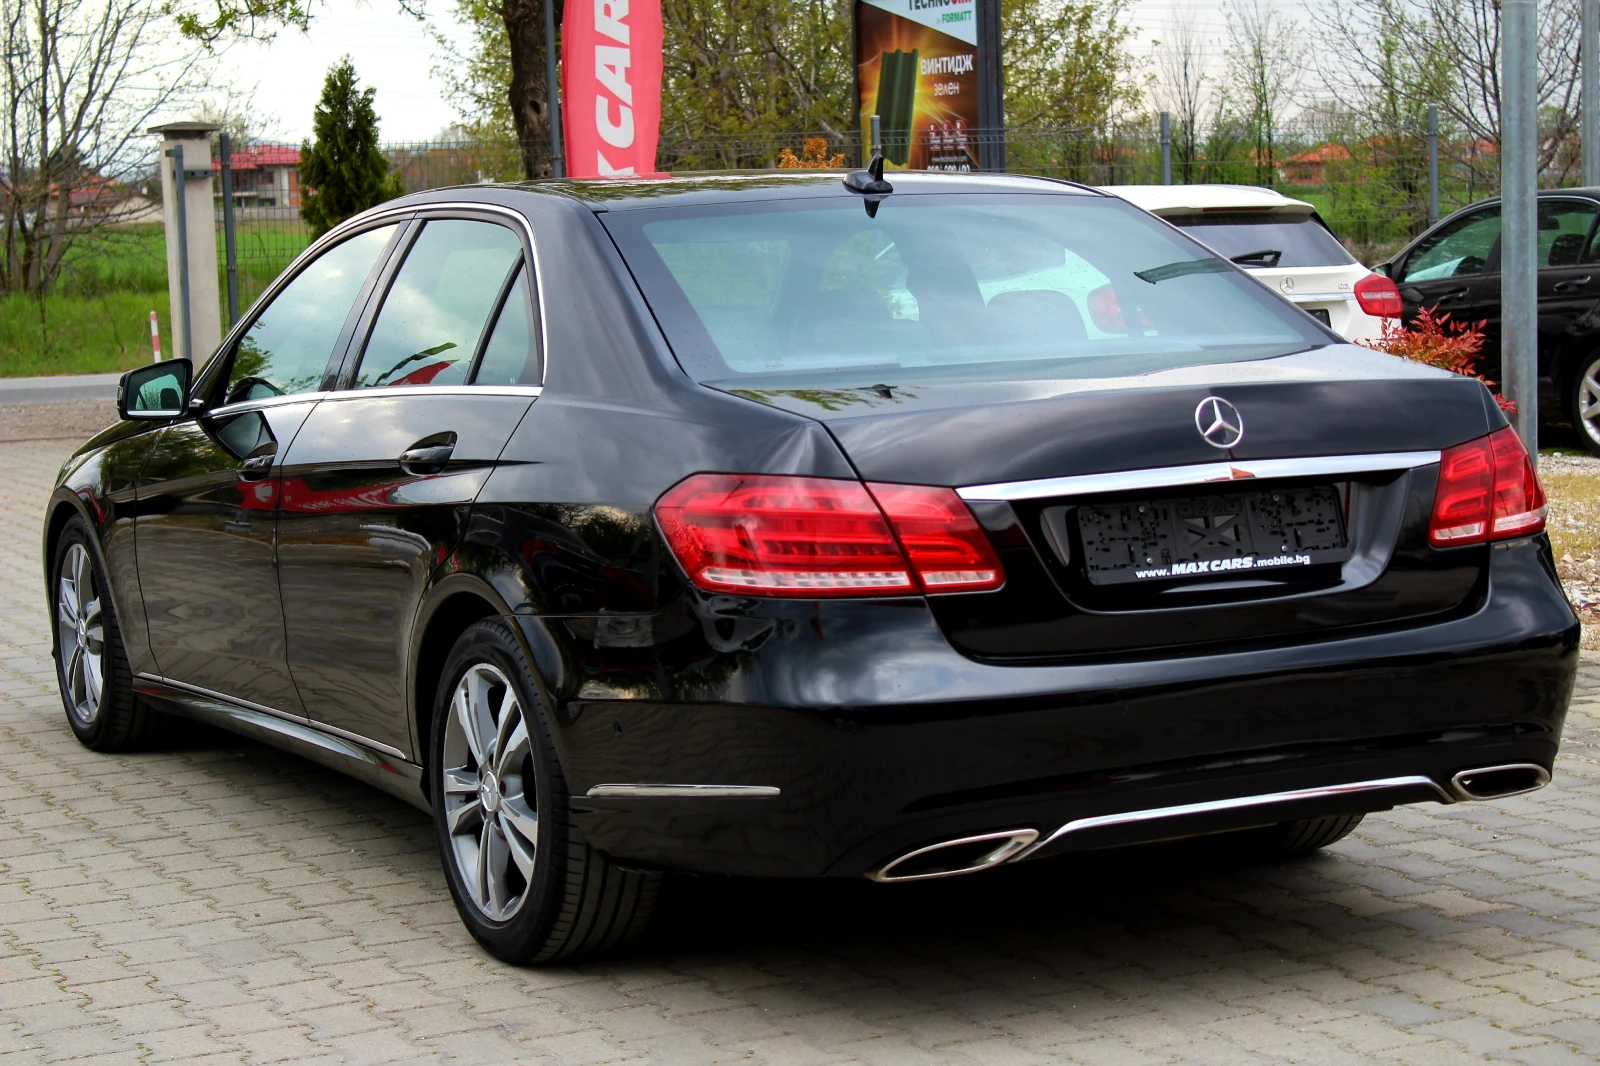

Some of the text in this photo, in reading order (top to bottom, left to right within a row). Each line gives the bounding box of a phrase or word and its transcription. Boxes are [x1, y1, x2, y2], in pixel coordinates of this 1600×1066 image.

[942, 10, 972, 24] FORMATT
[921, 54, 973, 76] ВИНТИДЖ
[933, 82, 960, 97] зелен
